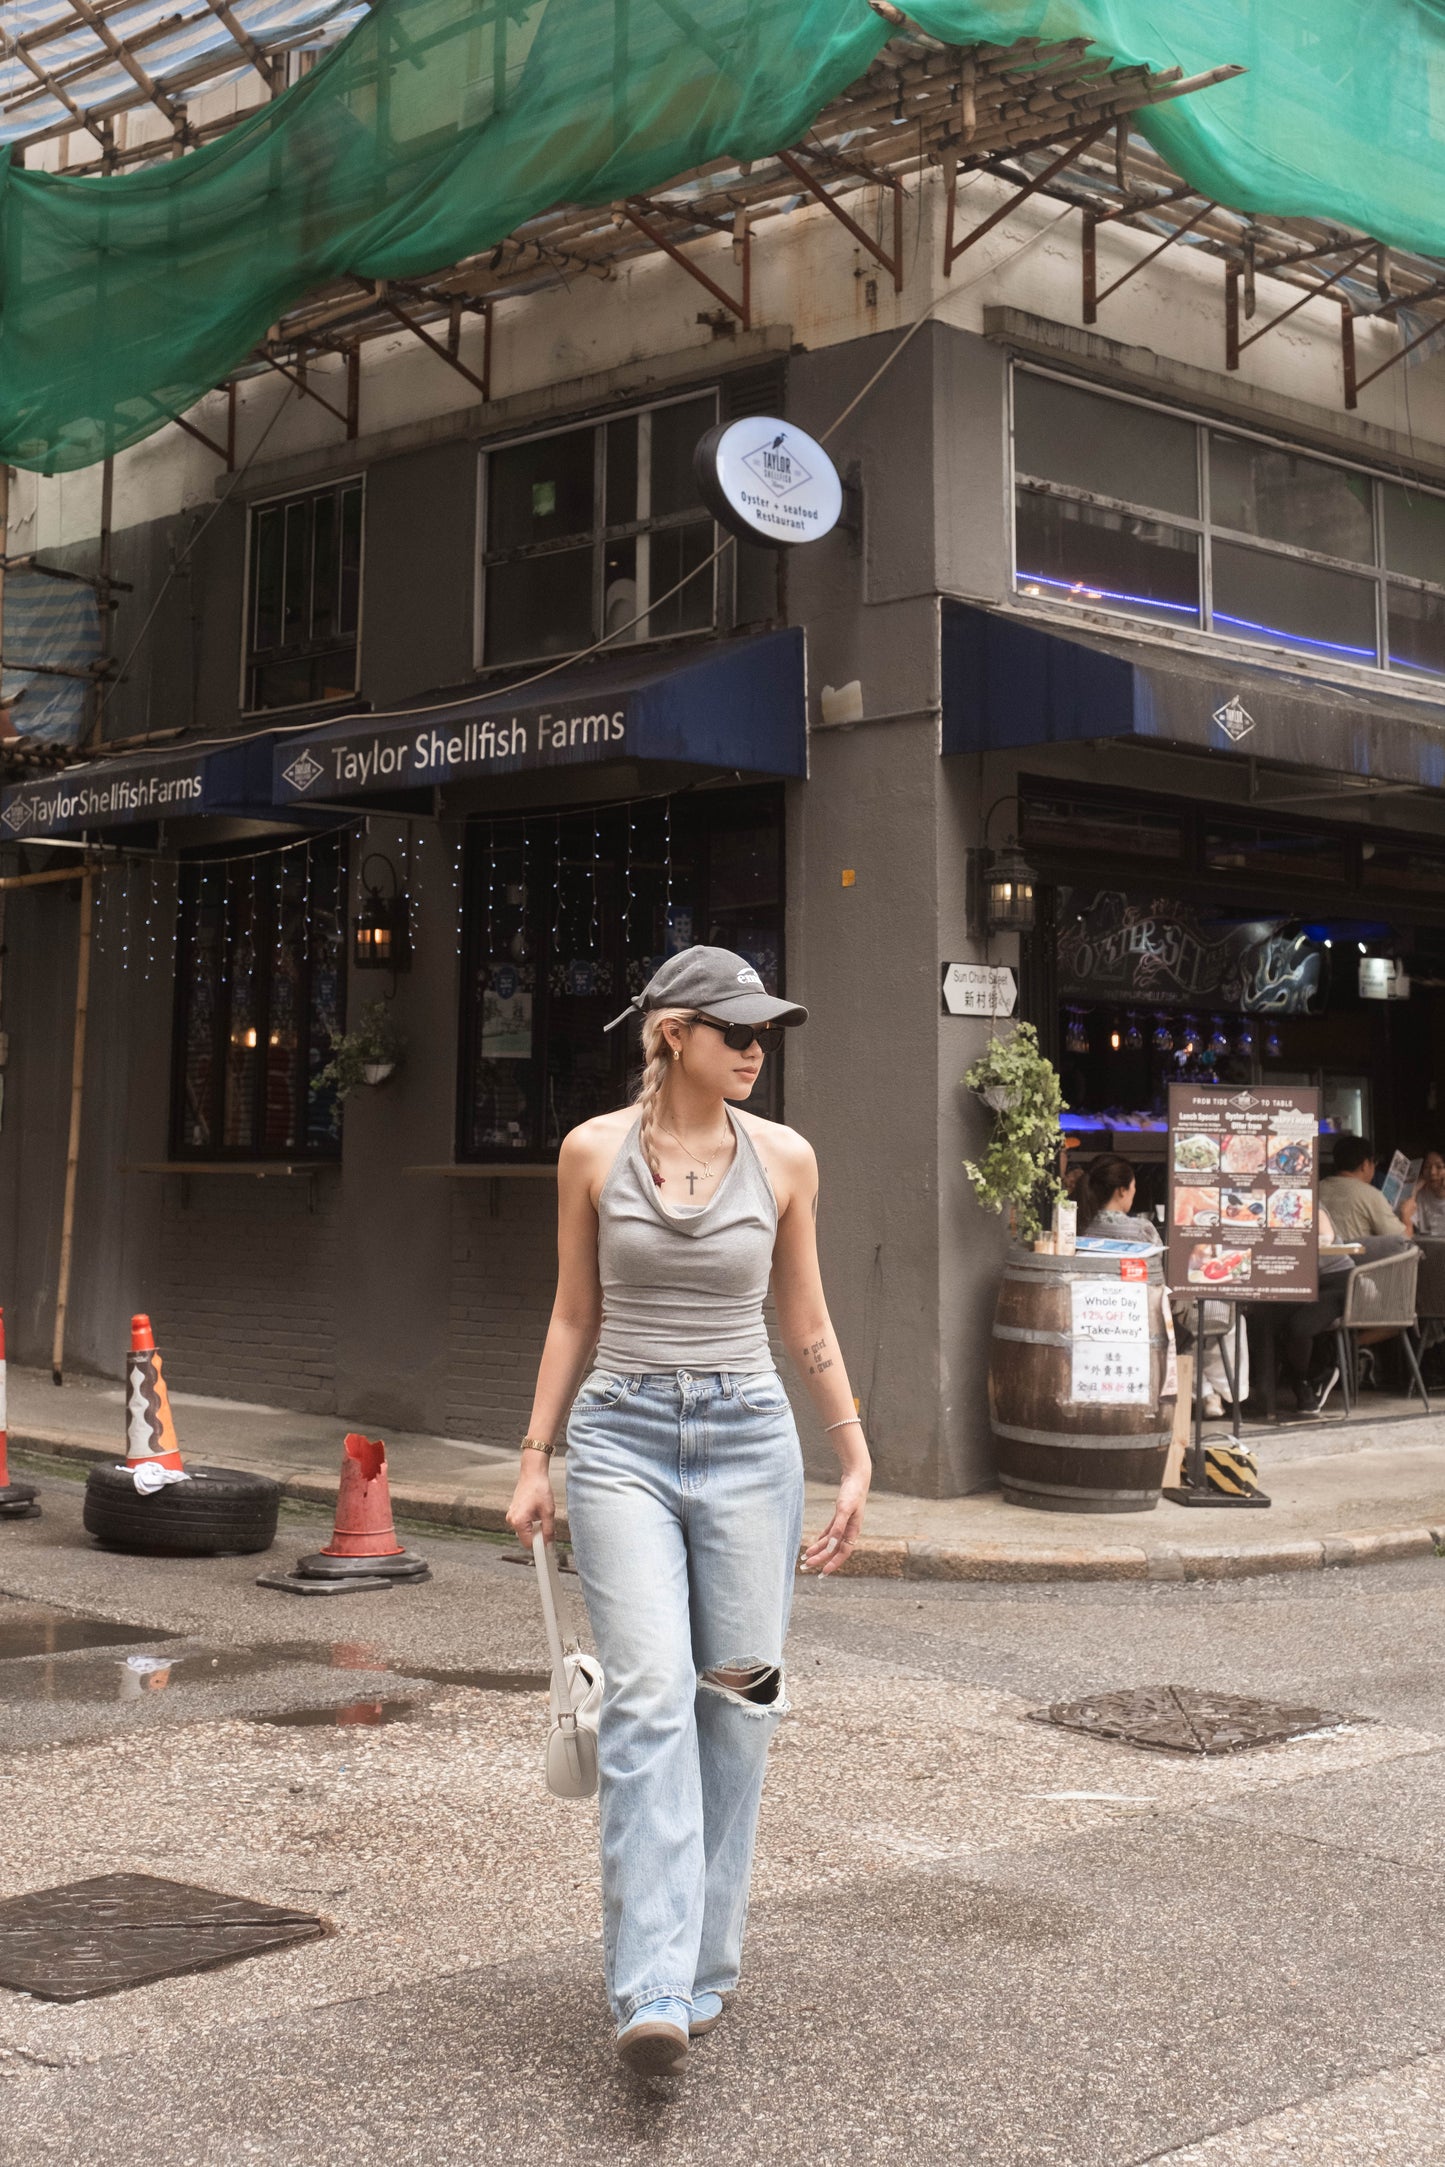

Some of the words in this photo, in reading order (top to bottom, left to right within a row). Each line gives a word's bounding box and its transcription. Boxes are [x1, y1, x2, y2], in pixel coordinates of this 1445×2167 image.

[763, 451, 791, 474] TAYLOR
[741, 491, 769, 505] Oyster
[783, 504, 818, 520] seafood
[756, 508, 805, 530] Restaurant
[331, 738, 408, 785] Taylor
[414, 717, 527, 769] Shellfish
[537, 710, 625, 751] Farms
[1074, 919, 1165, 978] OYSTER
[953, 969, 967, 983] Sun
[968, 970, 986, 984] Chun
[988, 972, 1008, 985] Seet
[964, 990, 998, 1009] 新村街
[1192, 1097, 1211, 1105] FROM
[1261, 1099, 1270, 1107] TO
[1273, 1099, 1293, 1107] TABLE
[1179, 1112, 1197, 1121] Lunch
[1198, 1112, 1220, 1122] Special
[1225, 1112, 1245, 1121] Oyster
[1246, 1112, 1268, 1122] Special
[1231, 1122, 1247, 1130] Offer
[1248, 1122, 1262, 1130] from
[1084, 1297, 1118, 1306] Whole
[1121, 1297, 1137, 1309] Day
[1081, 1310, 1103, 1321] 12%
[1105, 1311, 1125, 1321] OFF
[1128, 1313, 1141, 1322] for
[811, 1338, 826, 1354] girl
[817, 1359, 833, 1374] gun
